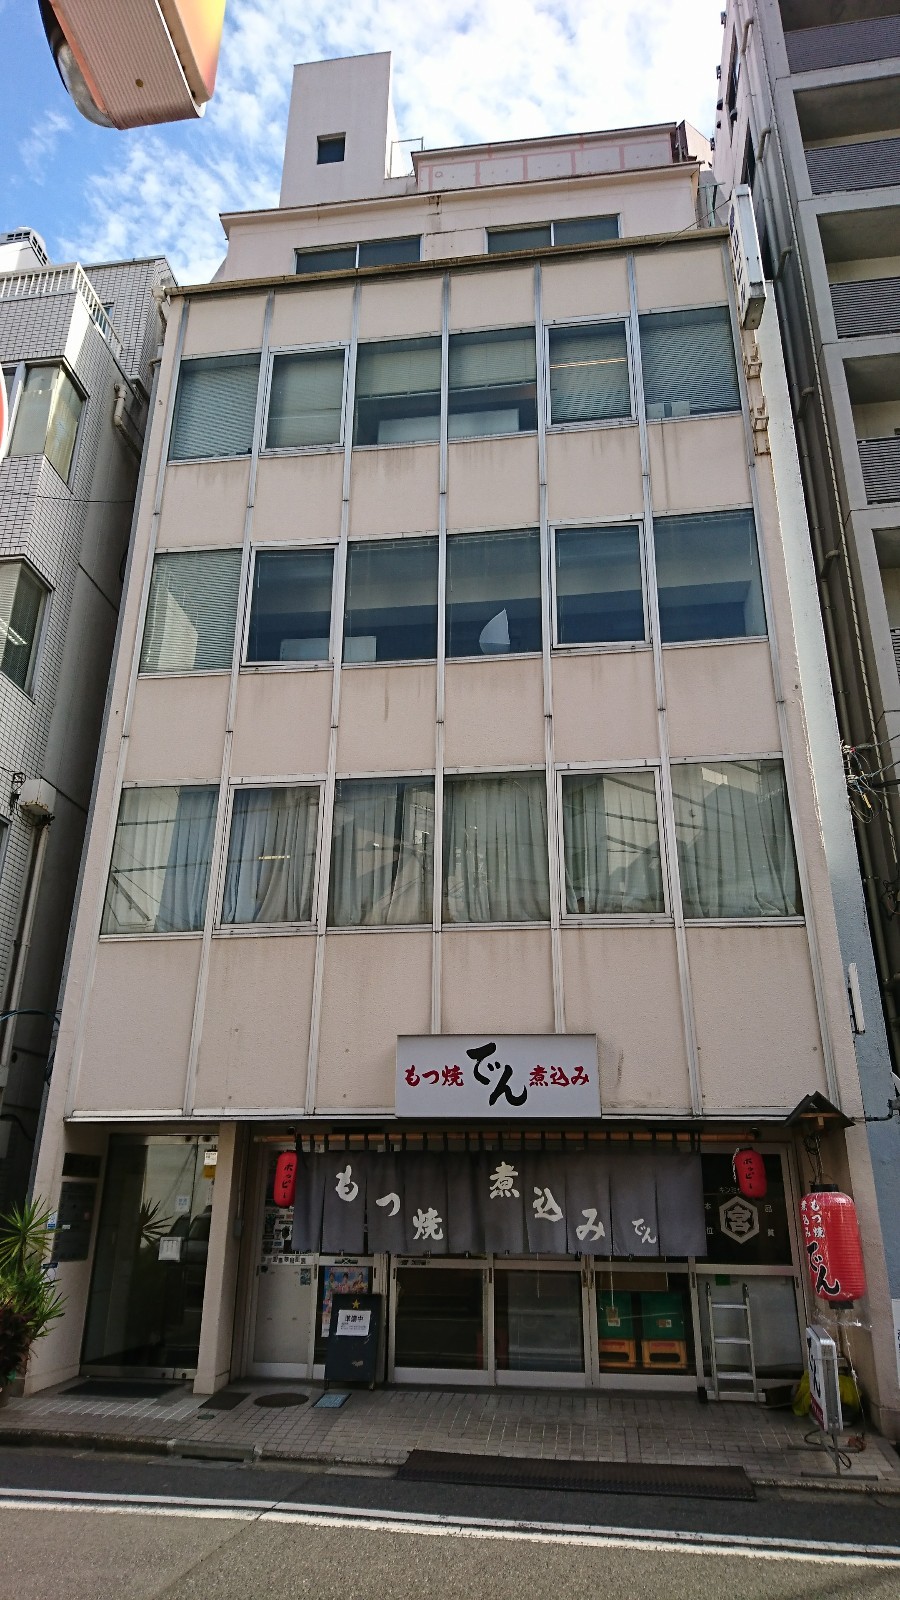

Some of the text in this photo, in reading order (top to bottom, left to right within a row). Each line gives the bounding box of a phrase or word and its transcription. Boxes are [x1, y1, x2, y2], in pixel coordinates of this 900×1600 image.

[405, 1042, 590, 1106] もつ焼 でん 煮込み
[335, 1161, 657, 1244] もつ焼 煮込み でん
[811, 1199, 825, 1238] もつ焼
[807, 1240, 840, 1296] でん
